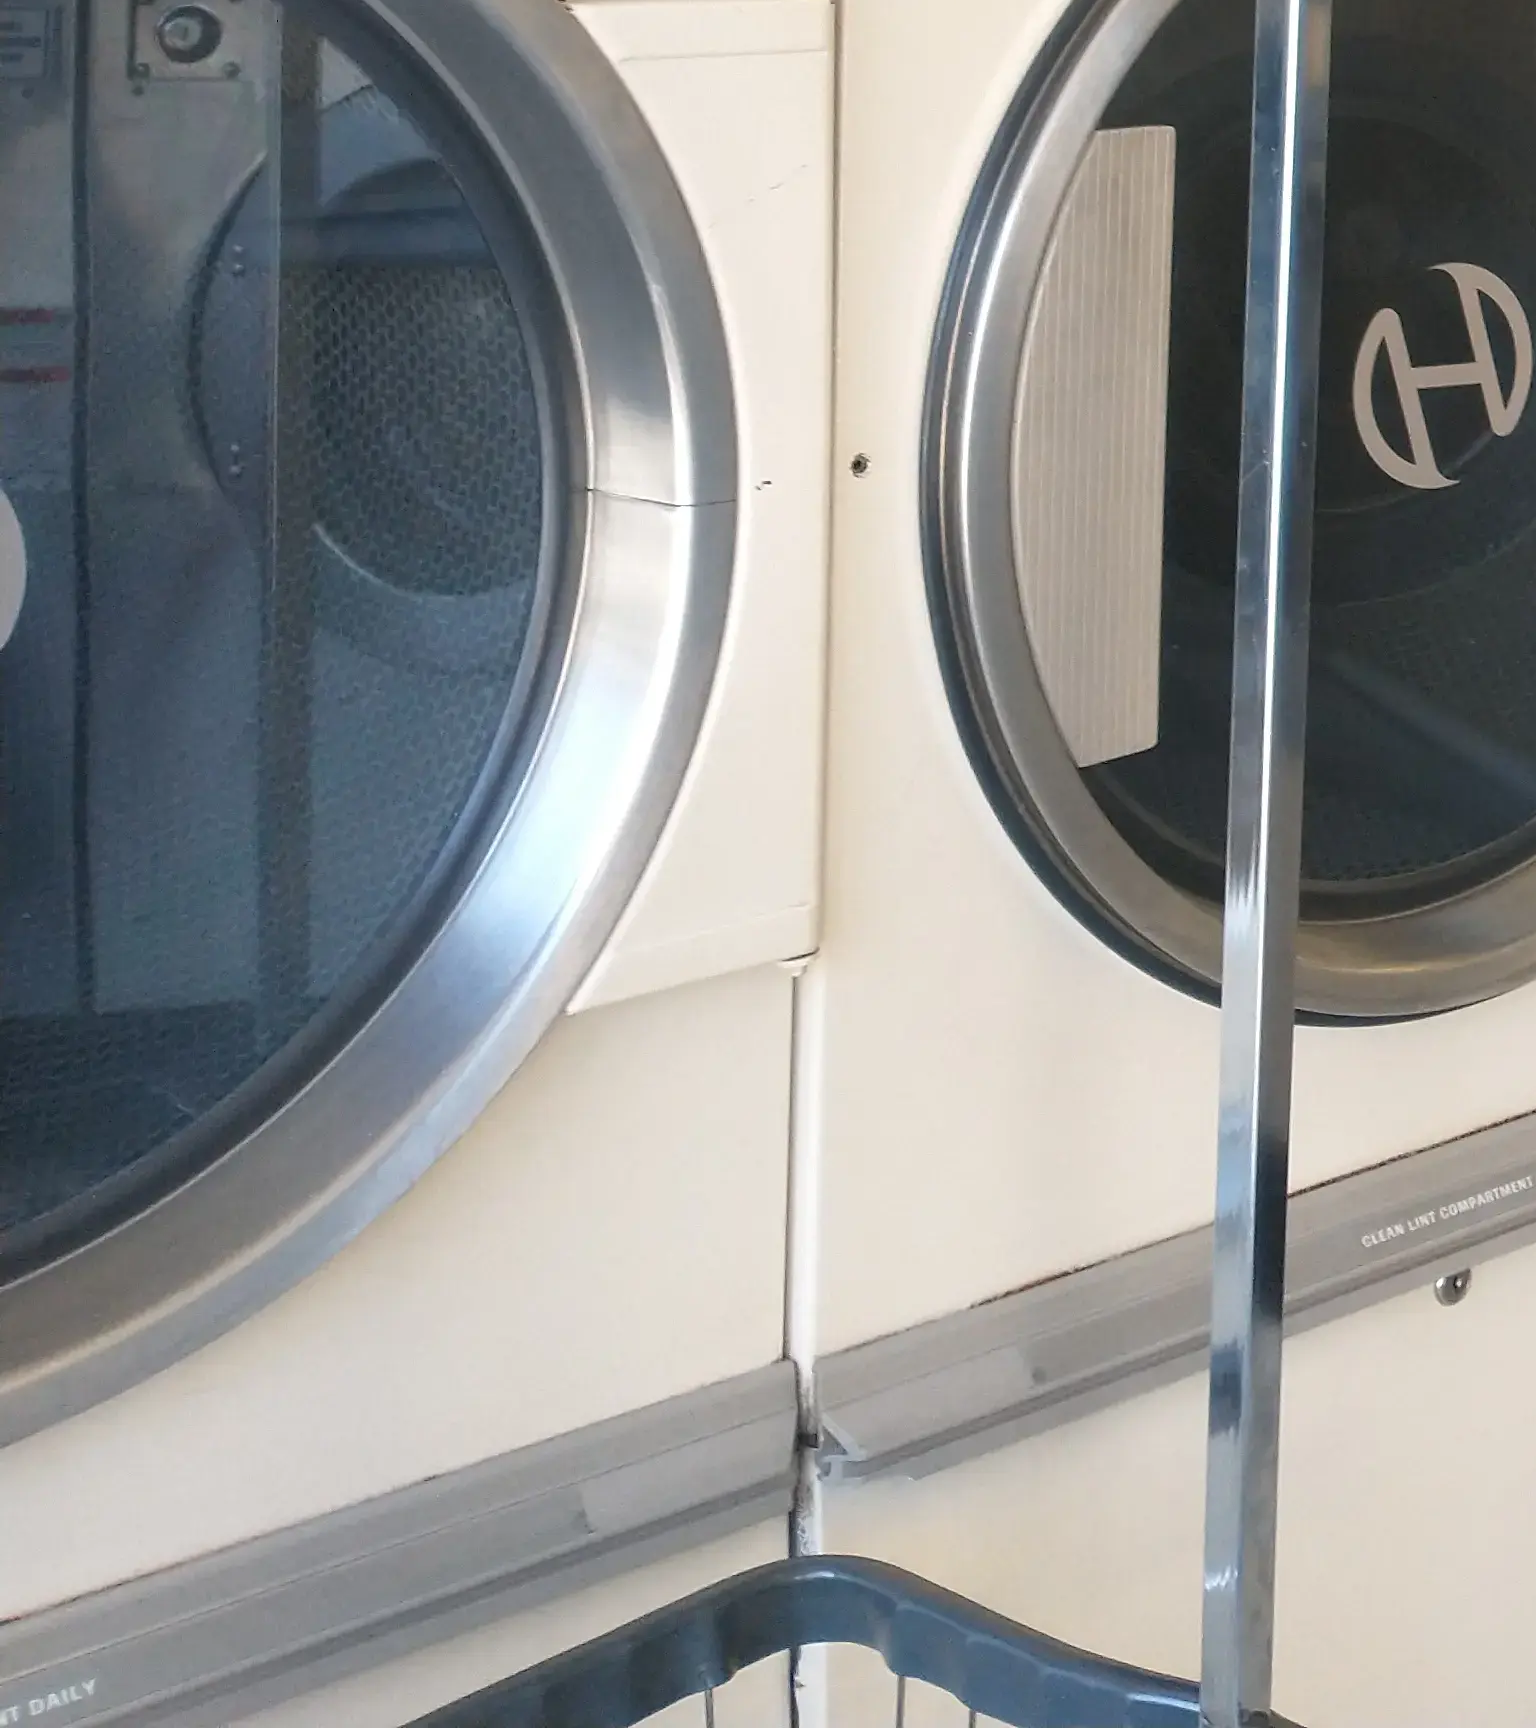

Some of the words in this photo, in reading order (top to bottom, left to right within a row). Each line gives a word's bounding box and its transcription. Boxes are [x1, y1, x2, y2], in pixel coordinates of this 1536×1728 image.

[1361, 1223, 1406, 1248] CLEAN
[1407, 1210, 1437, 1232] LINT
[1439, 1176, 1533, 1220] COMPARTMENT
[28, 1677, 97, 1716] DAILY
